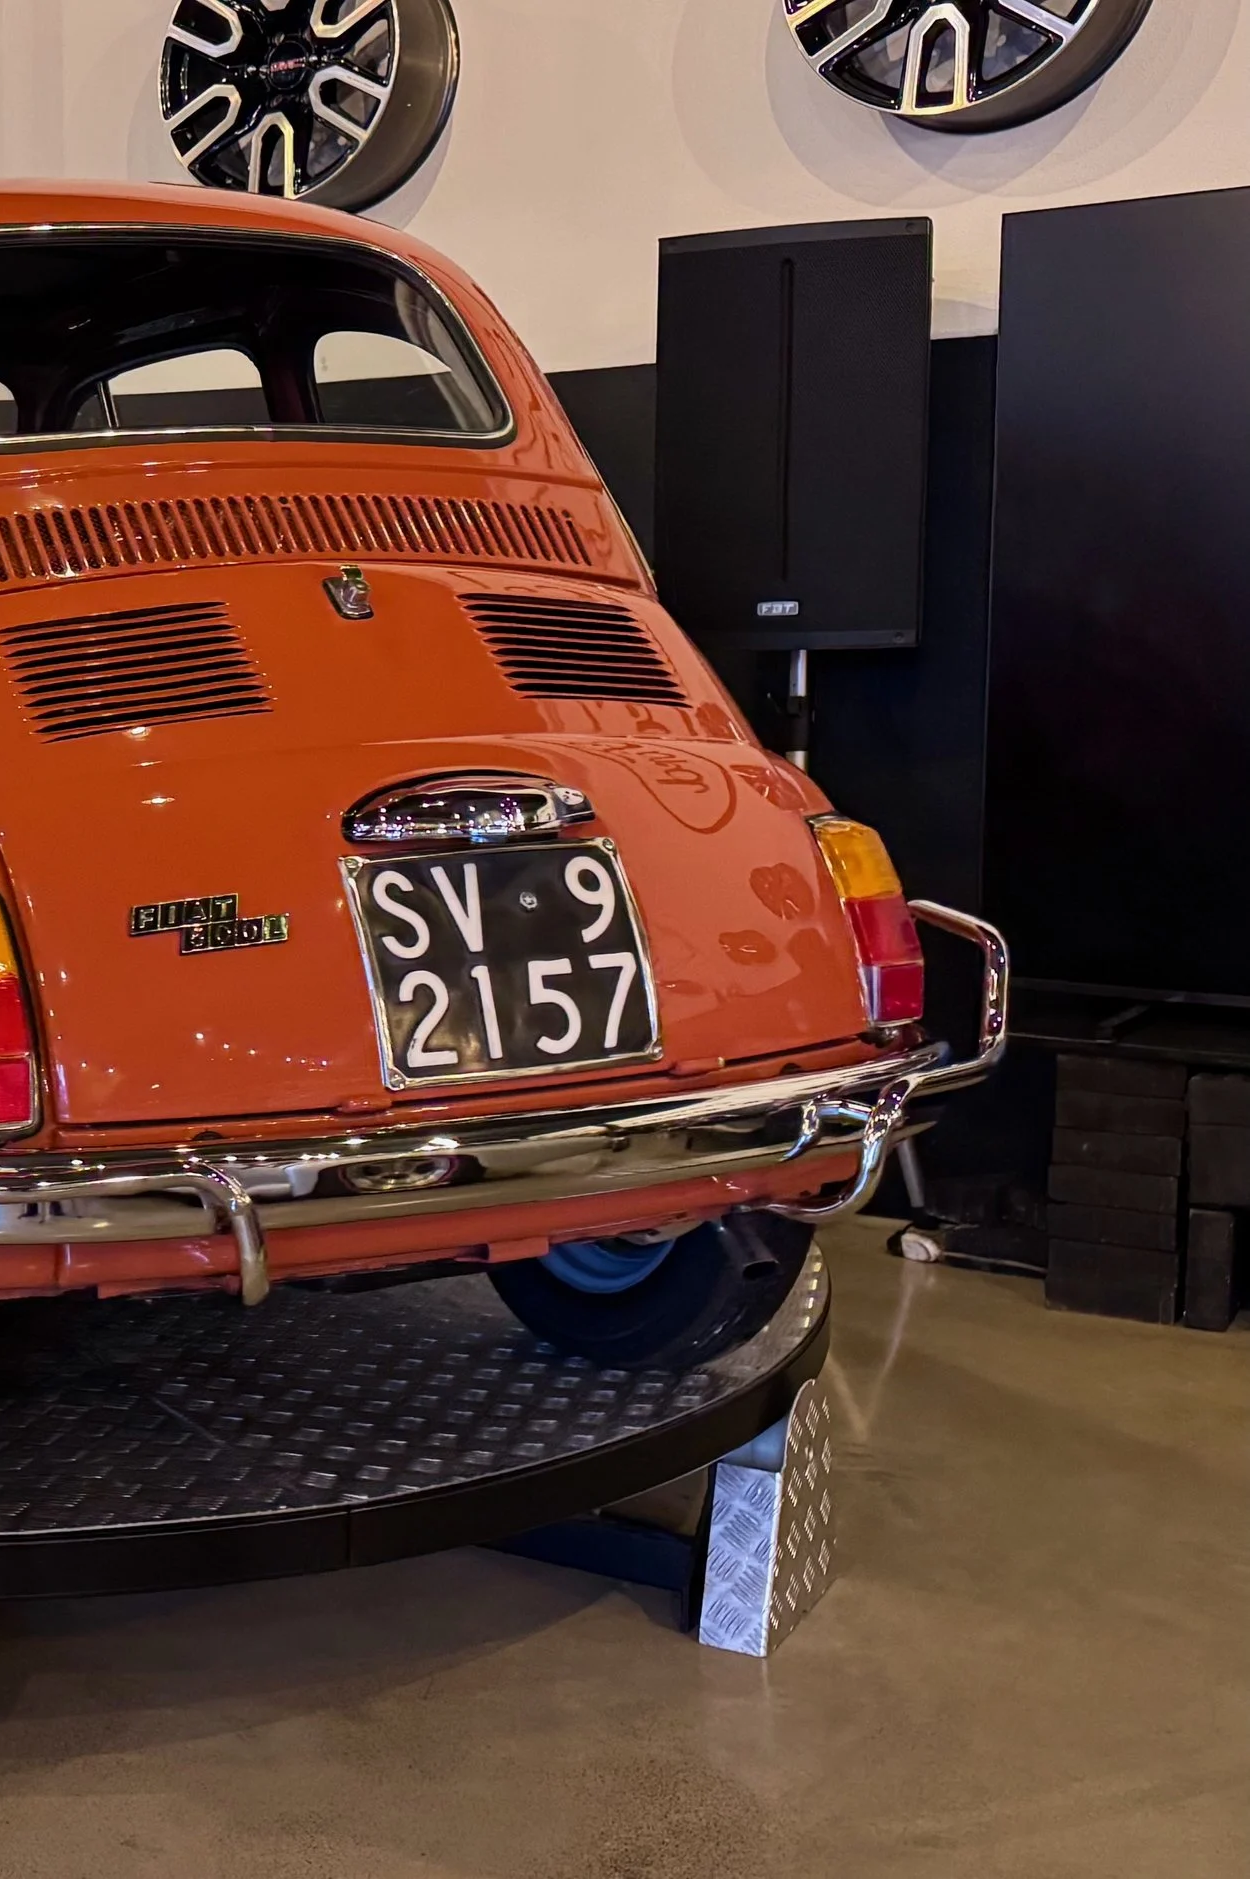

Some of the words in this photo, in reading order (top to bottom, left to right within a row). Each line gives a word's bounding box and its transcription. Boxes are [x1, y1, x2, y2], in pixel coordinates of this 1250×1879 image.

[137, 897, 234, 931] FIAT
[371, 862, 484, 960] SV
[564, 855, 616, 943] 9
[398, 951, 637, 1069] 2157
